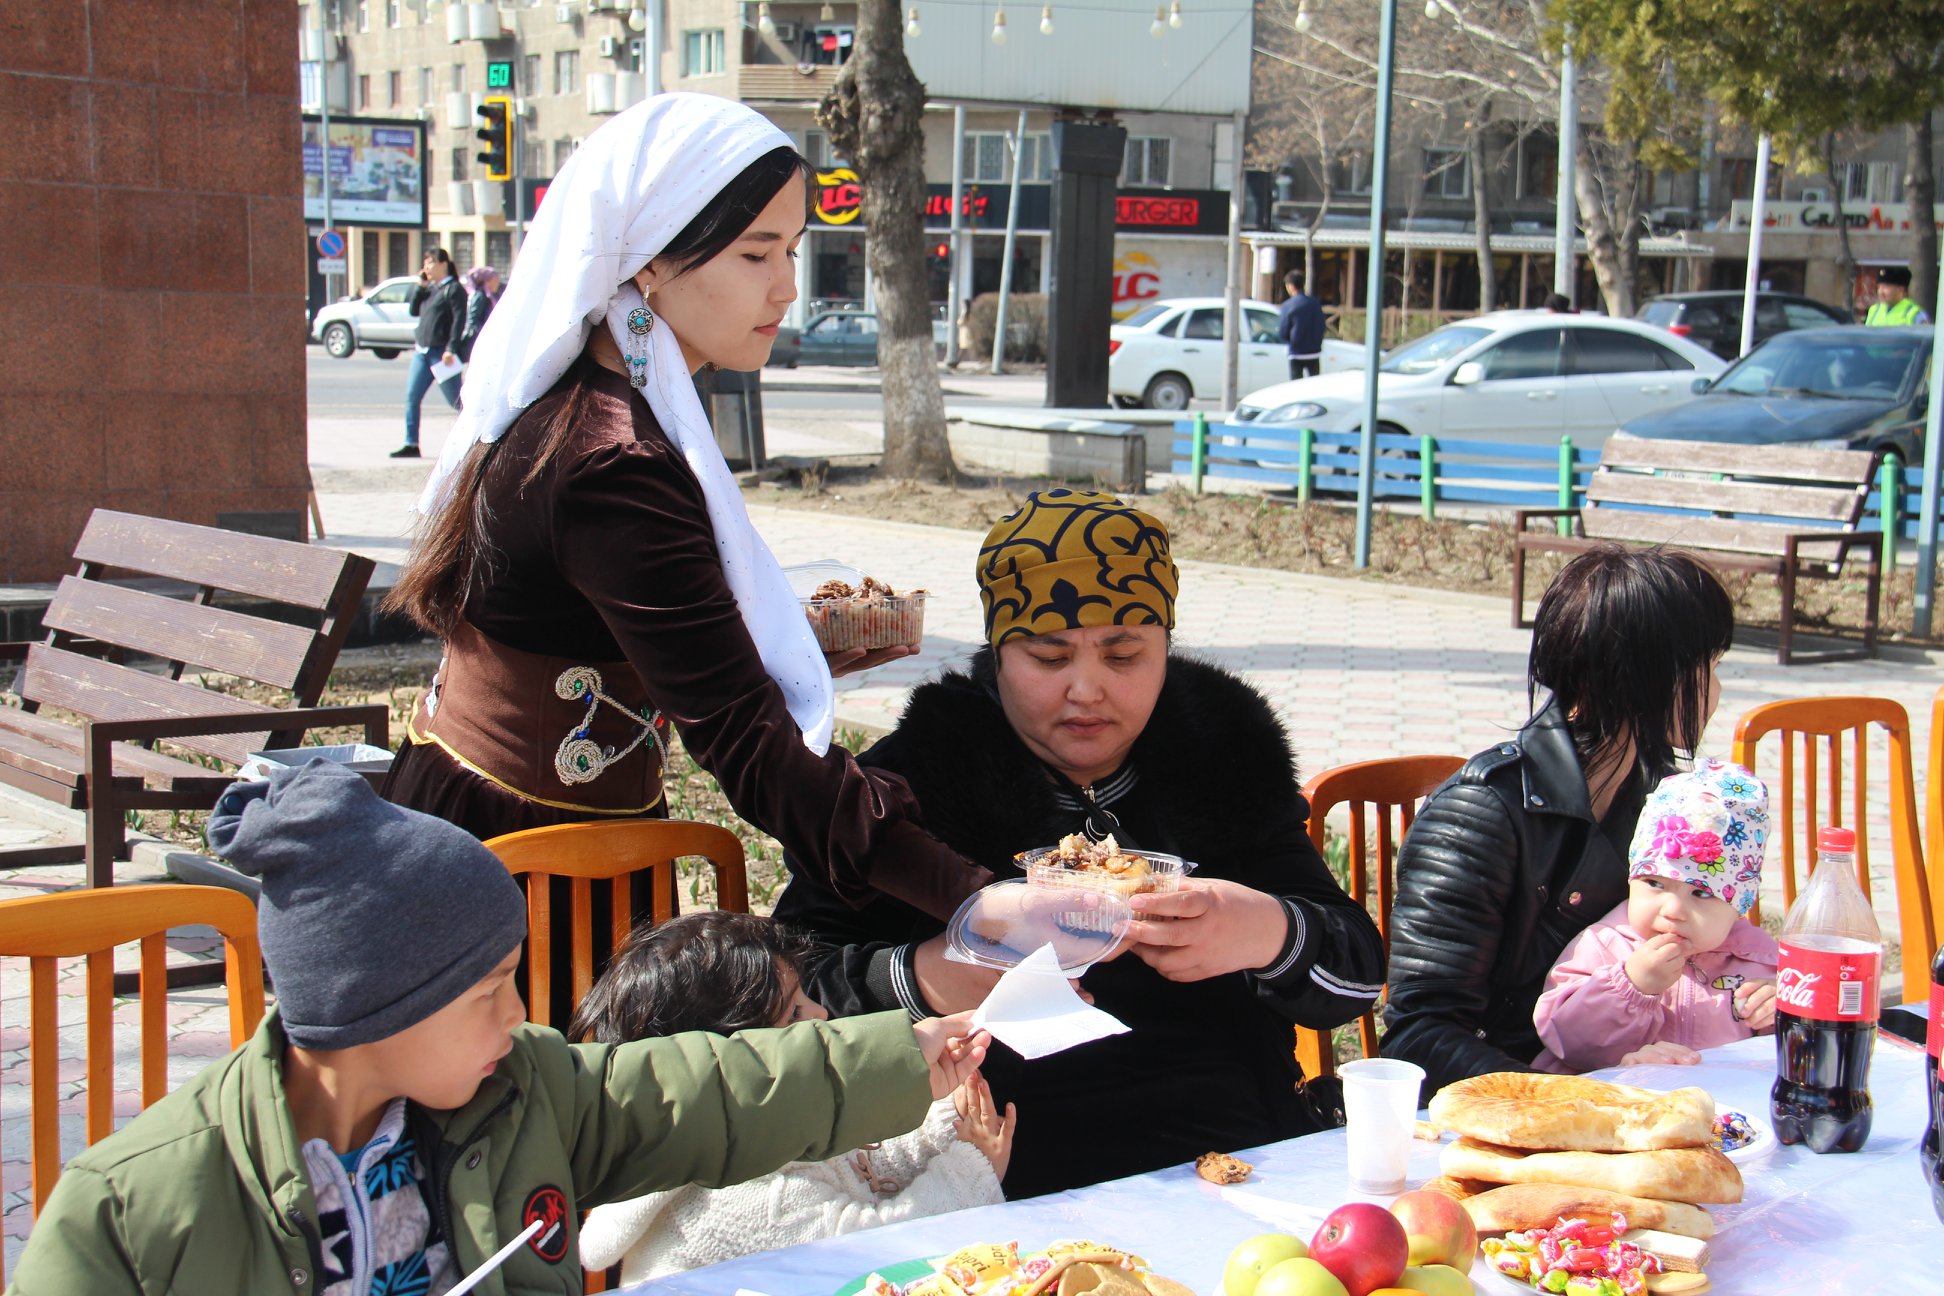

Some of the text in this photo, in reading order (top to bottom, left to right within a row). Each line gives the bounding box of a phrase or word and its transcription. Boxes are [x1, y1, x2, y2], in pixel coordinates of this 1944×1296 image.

[489, 63, 509, 86] 60
[1117, 200, 1195, 223] URGER
[1776, 967, 1822, 1008] Cola
